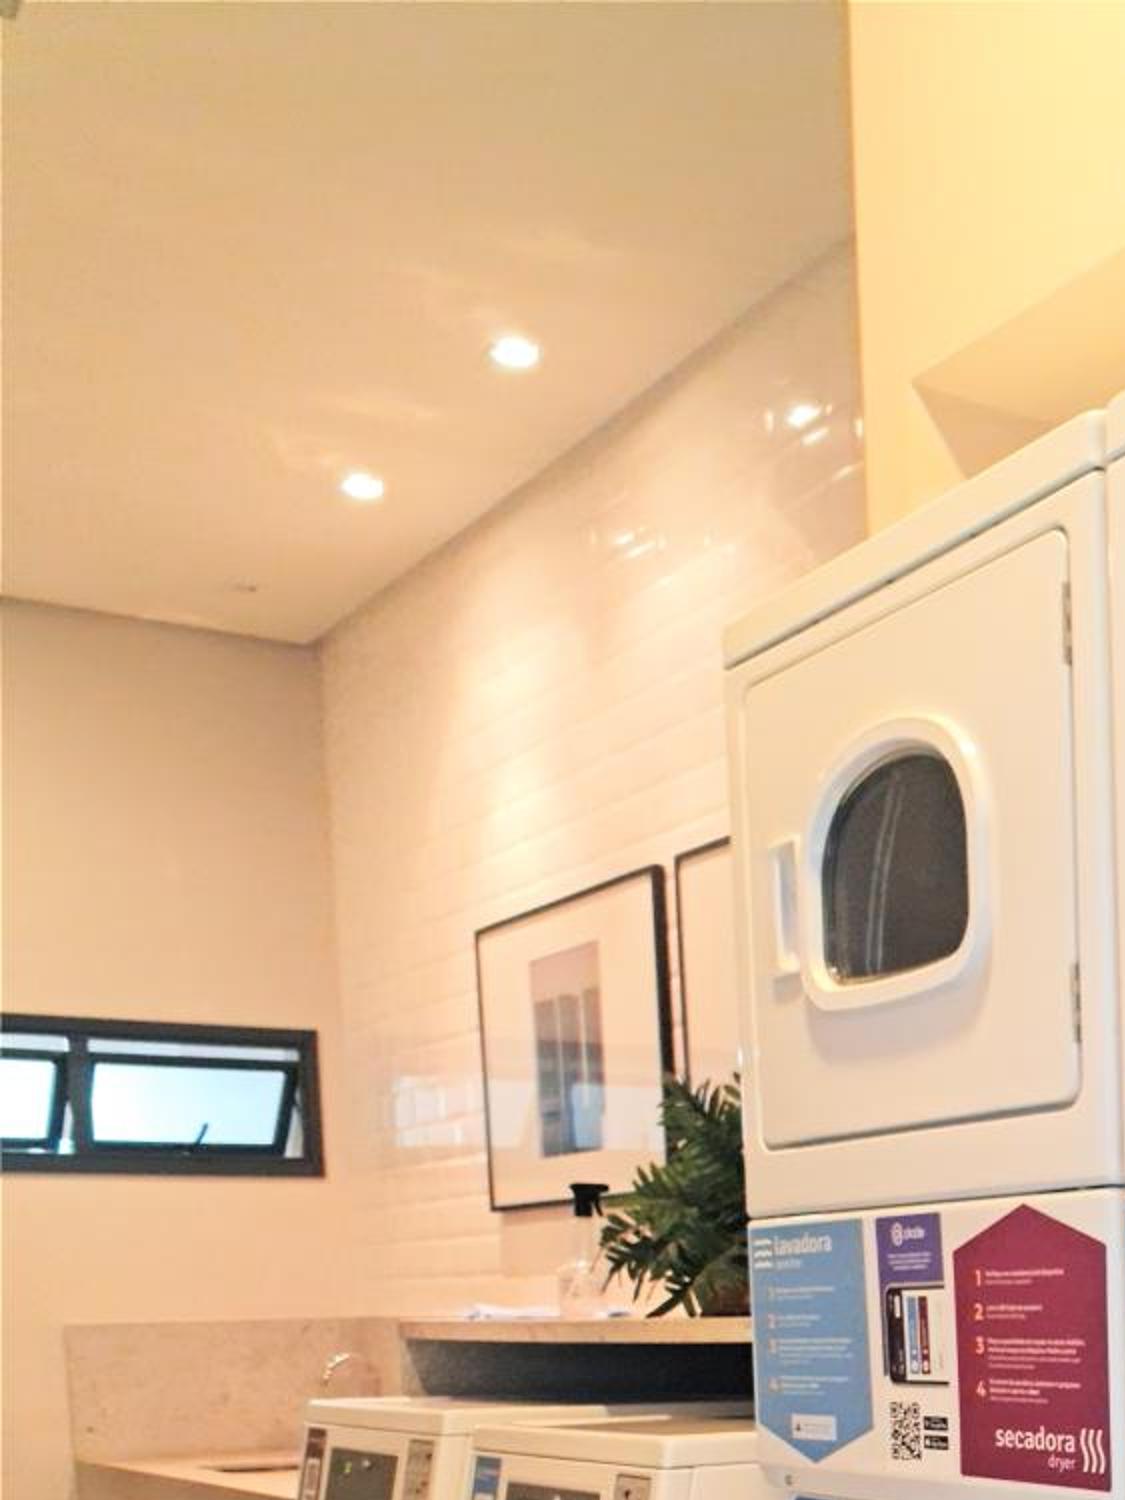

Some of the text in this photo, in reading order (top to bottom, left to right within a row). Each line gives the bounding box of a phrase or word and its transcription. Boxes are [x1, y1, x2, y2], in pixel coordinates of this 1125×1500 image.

[773, 1233, 834, 1257] lavadora
[975, 1269, 983, 1288] 1
[973, 1303, 984, 1321] 2
[975, 1337, 985, 1355] 3
[975, 1380, 987, 1396] 4
[995, 1425, 1076, 1453] secadora
[1047, 1453, 1077, 1473] dryer
